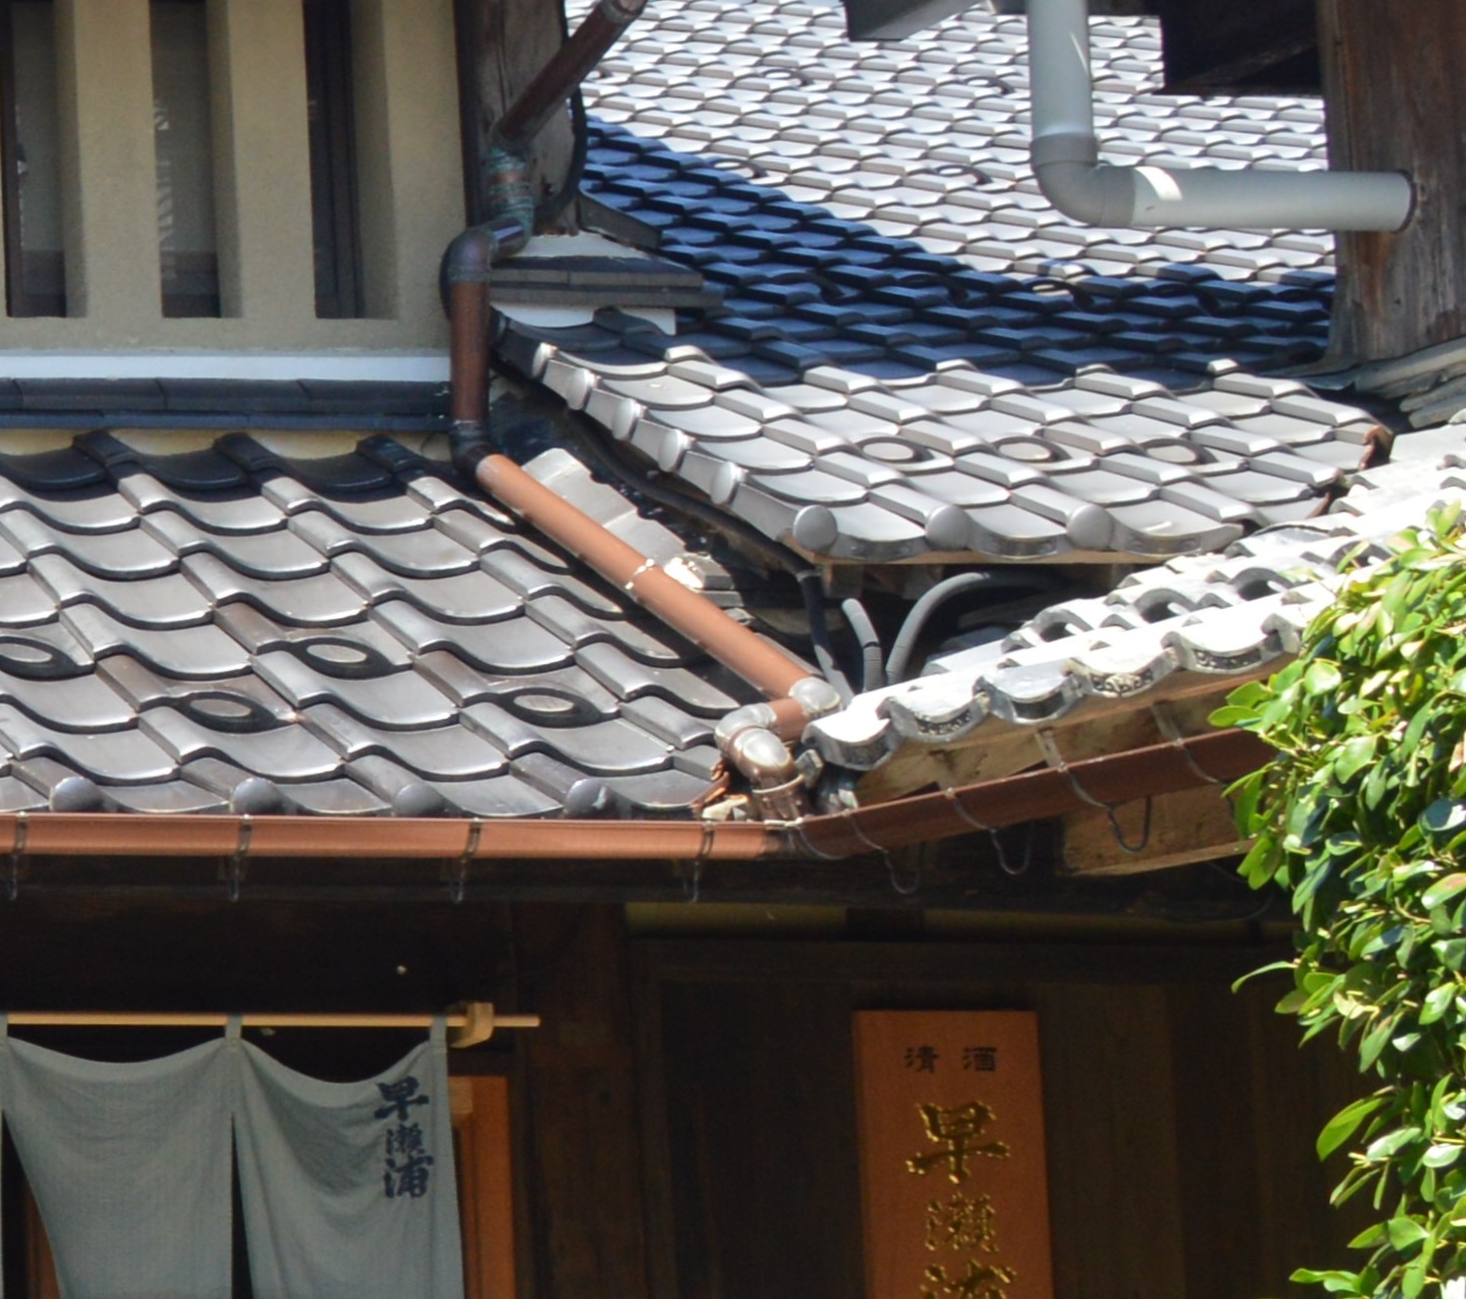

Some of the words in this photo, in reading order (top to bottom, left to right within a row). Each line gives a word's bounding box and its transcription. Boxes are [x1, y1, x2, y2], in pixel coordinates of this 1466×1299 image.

[903, 1045, 998, 1074] 清酒
[373, 1075, 434, 1198] 早瀬浦
